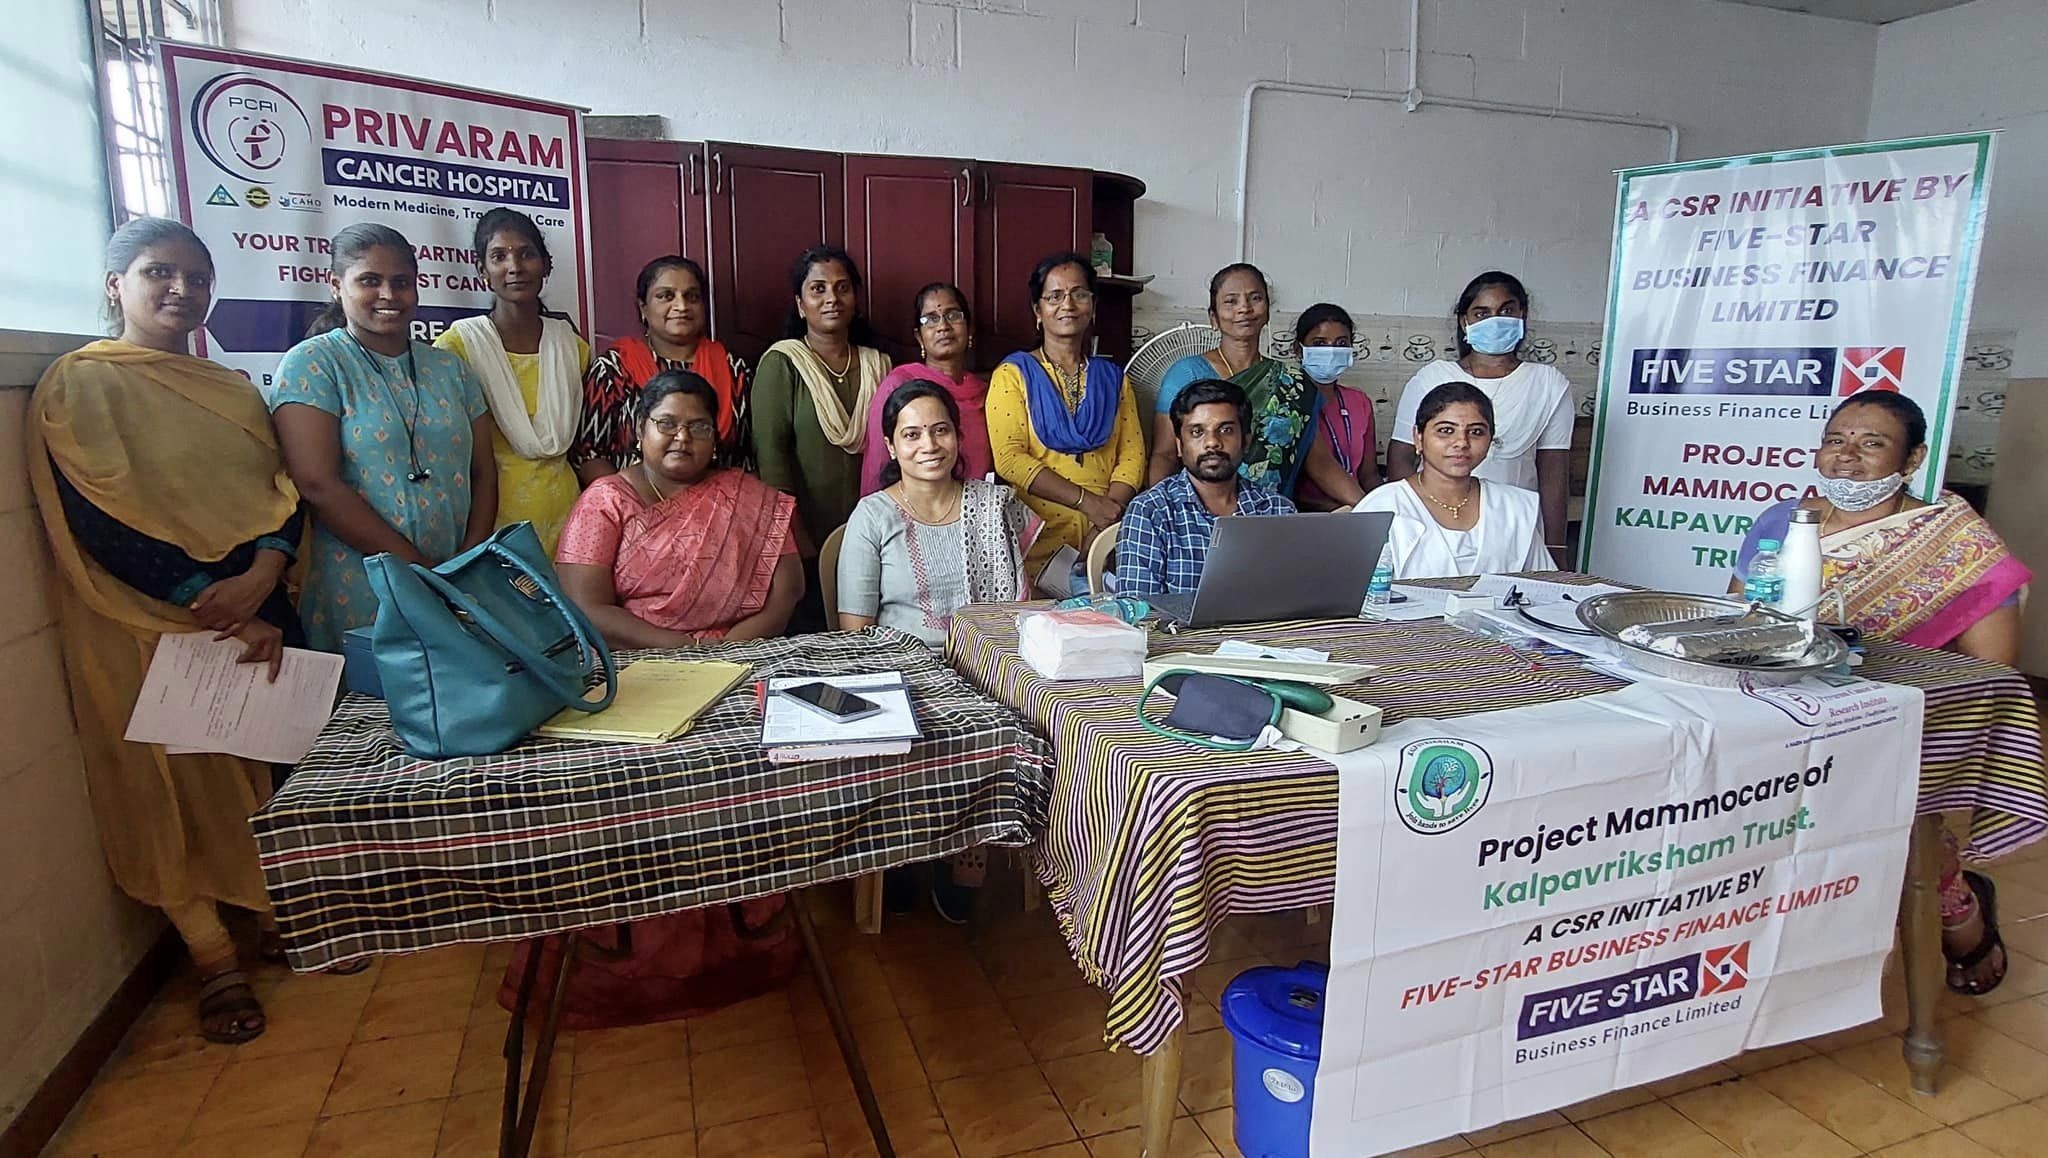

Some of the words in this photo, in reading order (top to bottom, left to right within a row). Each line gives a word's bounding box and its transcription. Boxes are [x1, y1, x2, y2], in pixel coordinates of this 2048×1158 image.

[229, 96, 278, 113] PCRI
[322, 103, 564, 169] PRIVARAM
[336, 158, 442, 190] CANCER
[447, 171, 560, 203] HOSPITAL
[333, 194, 390, 211] Modern
[394, 201, 460, 220] Medicine,
[536, 214, 565, 227] Care
[1628, 201, 1648, 222] A
[1659, 194, 1721, 219] CSR
[1728, 178, 1907, 214] INITIATIVE
[1912, 173, 1969, 201] BY
[232, 232, 300, 252] YOUR
[1697, 220, 1877, 252] FIVE-STAR
[279, 265, 328, 284] FIGH
[1632, 263, 1781, 291] BUSINESS
[1788, 255, 1951, 285] FINANCE
[1712, 299, 1840, 323] LIMITED
[1641, 359, 1715, 384] FIVE
[1724, 359, 1823, 385] STAR
[1627, 401, 1712, 417] Business
[1719, 403, 1801, 420] Finance
[1682, 443, 1819, 469] PROJECT
[1643, 475, 1819, 501] MAMMOCA
[1615, 507, 1753, 535] KALPAVR
[1478, 815, 1598, 867] Project
[1604, 773, 1800, 838] Mammocare
[1803, 756, 1834, 788] of
[1483, 834, 1736, 910] Kalpavriksham
[1743, 805, 1816, 849] Trust.
[1523, 924, 1544, 946] A
[1550, 910, 1605, 938] CSR
[1607, 878, 1733, 926] INITIATIVE
[1736, 866, 1766, 893] BY
[1401, 955, 1543, 1009] FIVE-STAR
[1547, 930, 1669, 973] BUSINESS
[1672, 896, 1773, 942] FINANCE
[1775, 874, 1861, 916] LIMITED
[1528, 993, 1602, 1030] FIVE
[1606, 965, 1691, 1008] STAR
[1514, 1035, 1598, 1065] Business
[1602, 1013, 1671, 1045] Finance
[1675, 995, 1742, 1025] Limited
